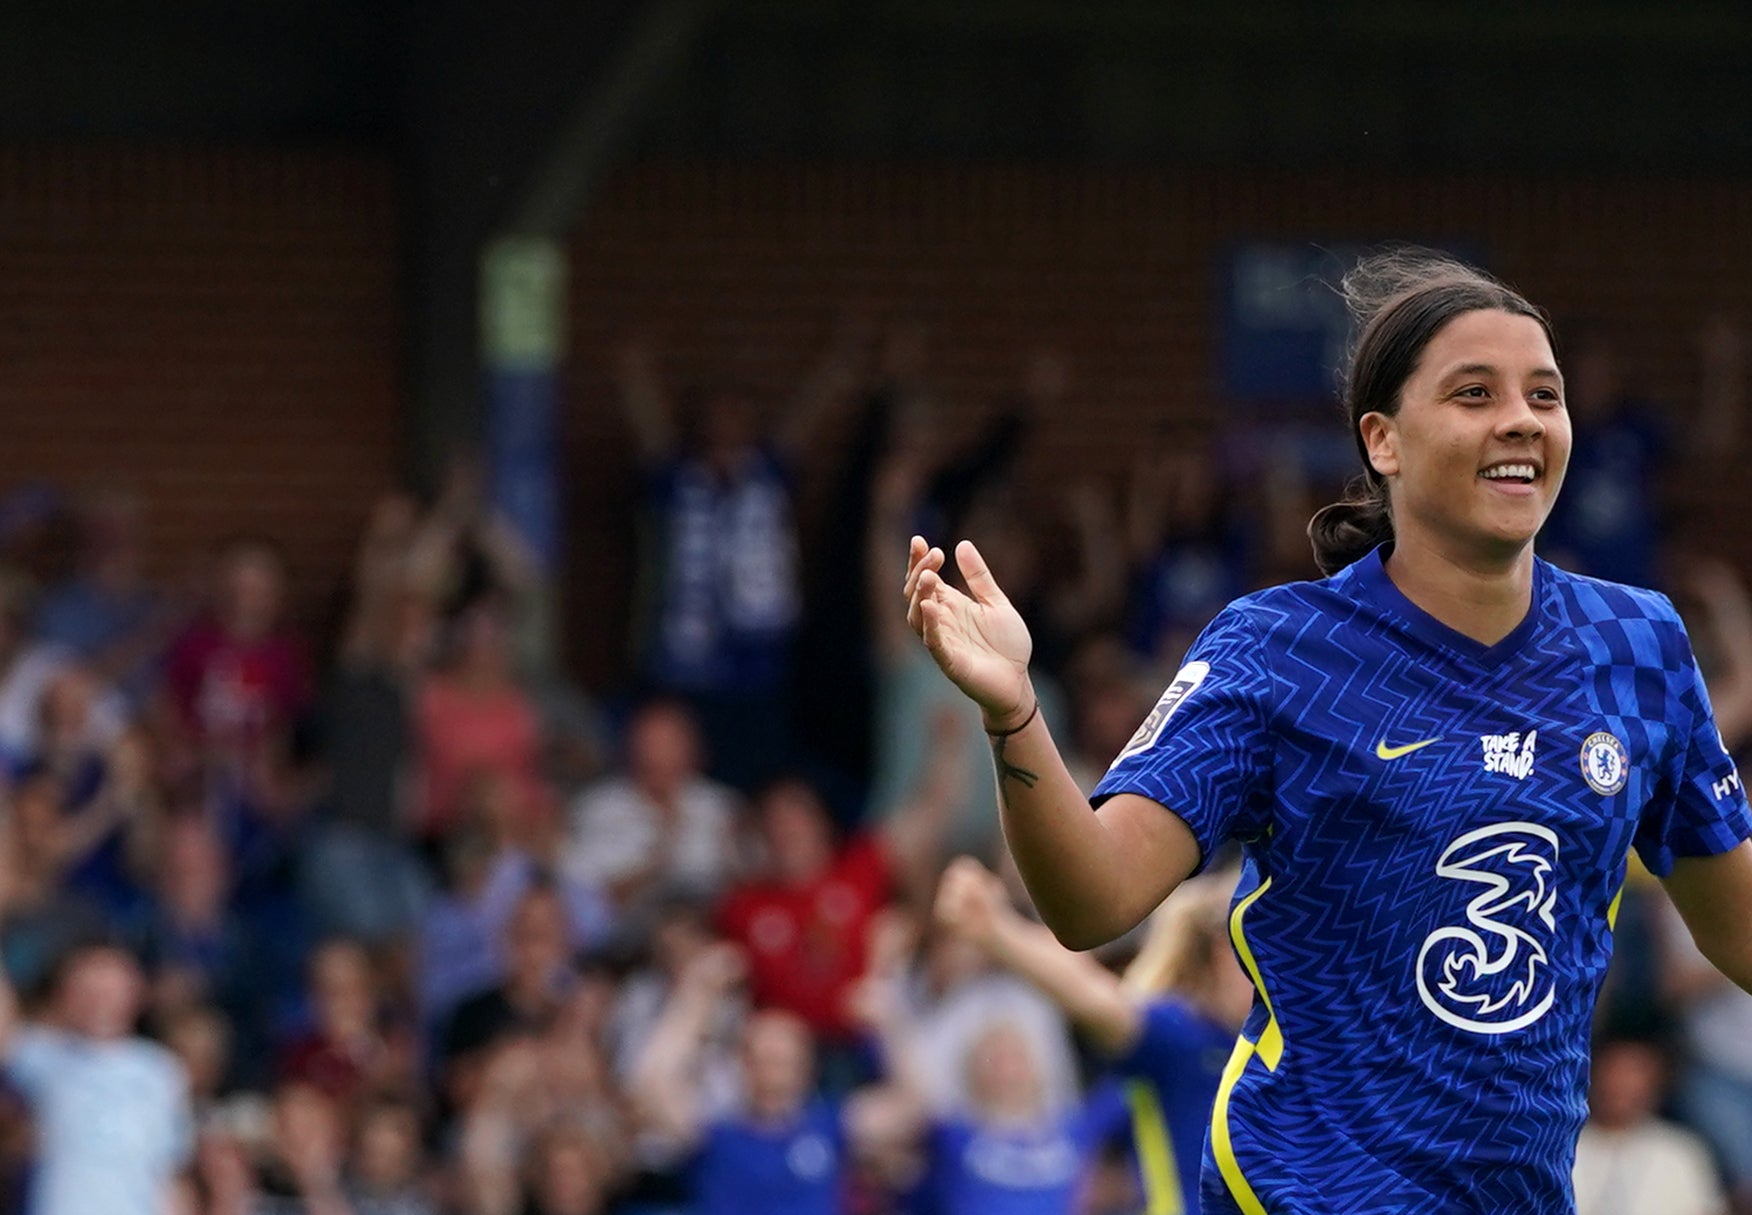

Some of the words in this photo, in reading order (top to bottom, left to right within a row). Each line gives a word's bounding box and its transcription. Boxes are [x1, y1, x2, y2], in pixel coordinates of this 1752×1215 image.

[1480, 732, 1520, 753] TAKE
[1523, 730, 1537, 752] A
[1483, 751, 1535, 780] STAND.
